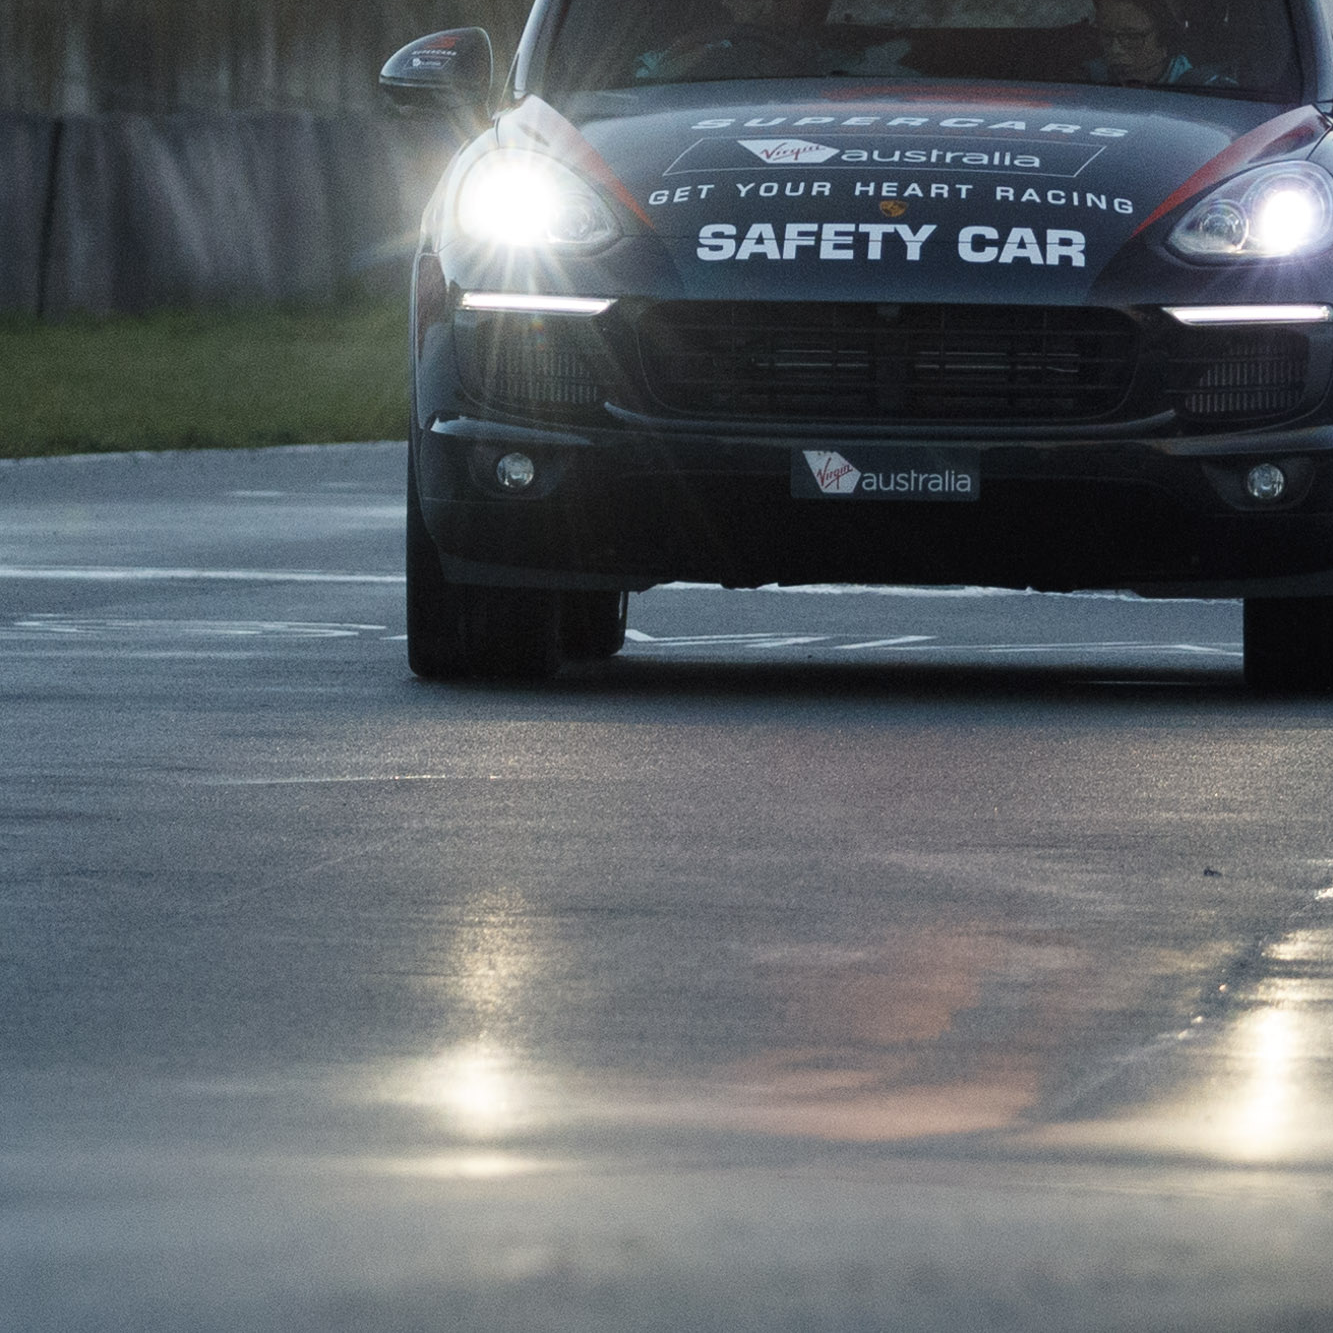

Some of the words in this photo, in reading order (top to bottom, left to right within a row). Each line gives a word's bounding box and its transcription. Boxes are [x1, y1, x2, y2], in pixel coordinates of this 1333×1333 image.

[690, 115, 1132, 139] SUPERCARS
[759, 142, 827, 163] Virgin
[840, 146, 1041, 168] australia
[647, 184, 715, 206] GET
[736, 181, 832, 198] YOUR
[854, 181, 974, 200] HEART
[995, 186, 1134, 215] RACING
[696, 222, 938, 262] SAFETY
[957, 225, 1086, 267] CAR
[816, 456, 853, 491] Virgin
[861, 469, 972, 493] australia
